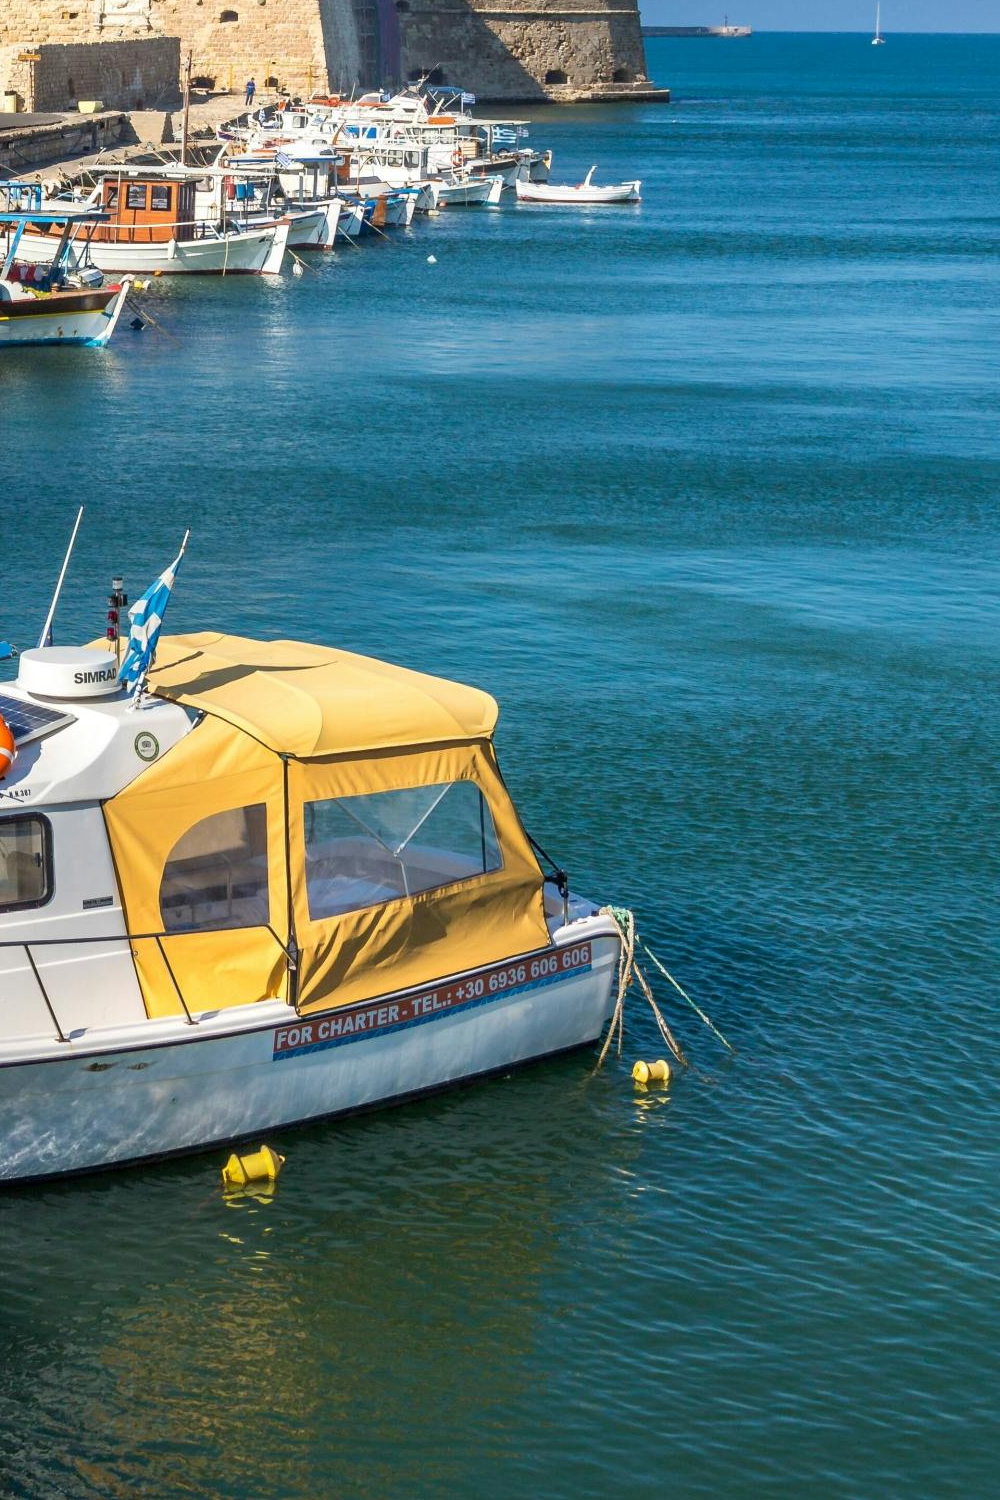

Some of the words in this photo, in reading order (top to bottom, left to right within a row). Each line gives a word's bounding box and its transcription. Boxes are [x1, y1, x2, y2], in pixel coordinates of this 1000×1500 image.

[74, 668, 117, 684] SIMRAD
[276, 1025, 313, 1050] FOR
[318, 1005, 399, 1040] CHARTER
[412, 992, 452, 1017] TEL.:
[456, 978, 484, 1000] +30
[488, 965, 526, 992] 6936
[530, 955, 558, 978] 606
[562, 946, 590, 969] 606
